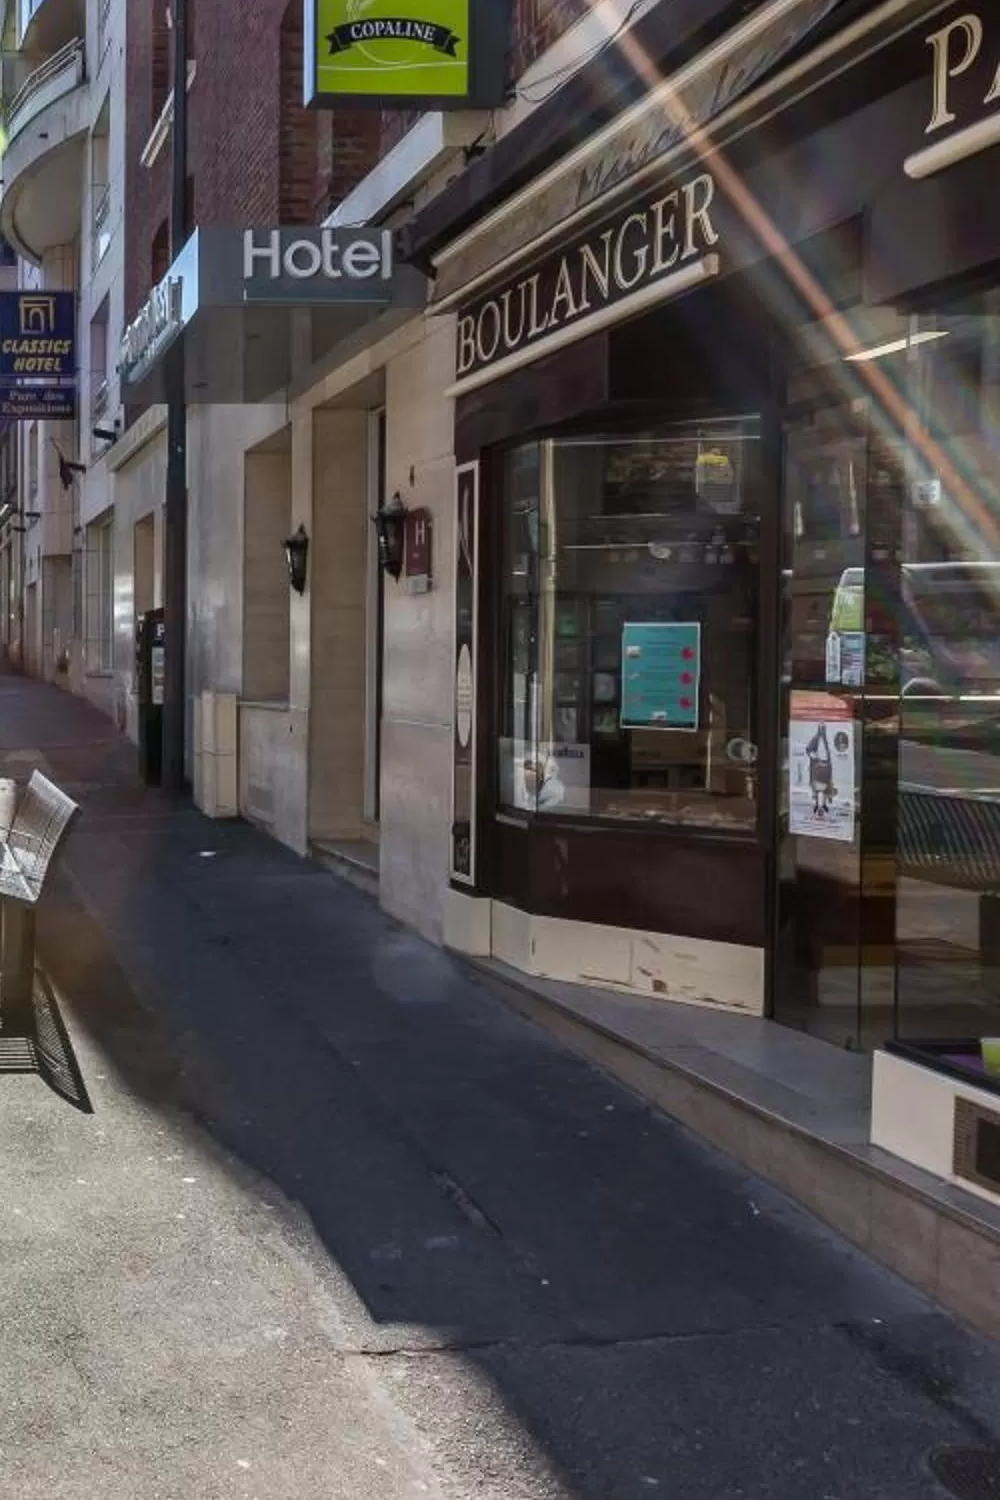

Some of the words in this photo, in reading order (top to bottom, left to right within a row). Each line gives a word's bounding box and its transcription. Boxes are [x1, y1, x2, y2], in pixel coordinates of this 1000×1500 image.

[351, 20, 437, 41] COPALINE
[925, 13, 1000, 134] P
[243, 229, 392, 279] Hotel
[456, 173, 719, 373] BOULANGER
[2, 340, 72, 354] CLASSICS
[14, 358, 62, 372] HOTEL
[415, 519, 425, 547] H
